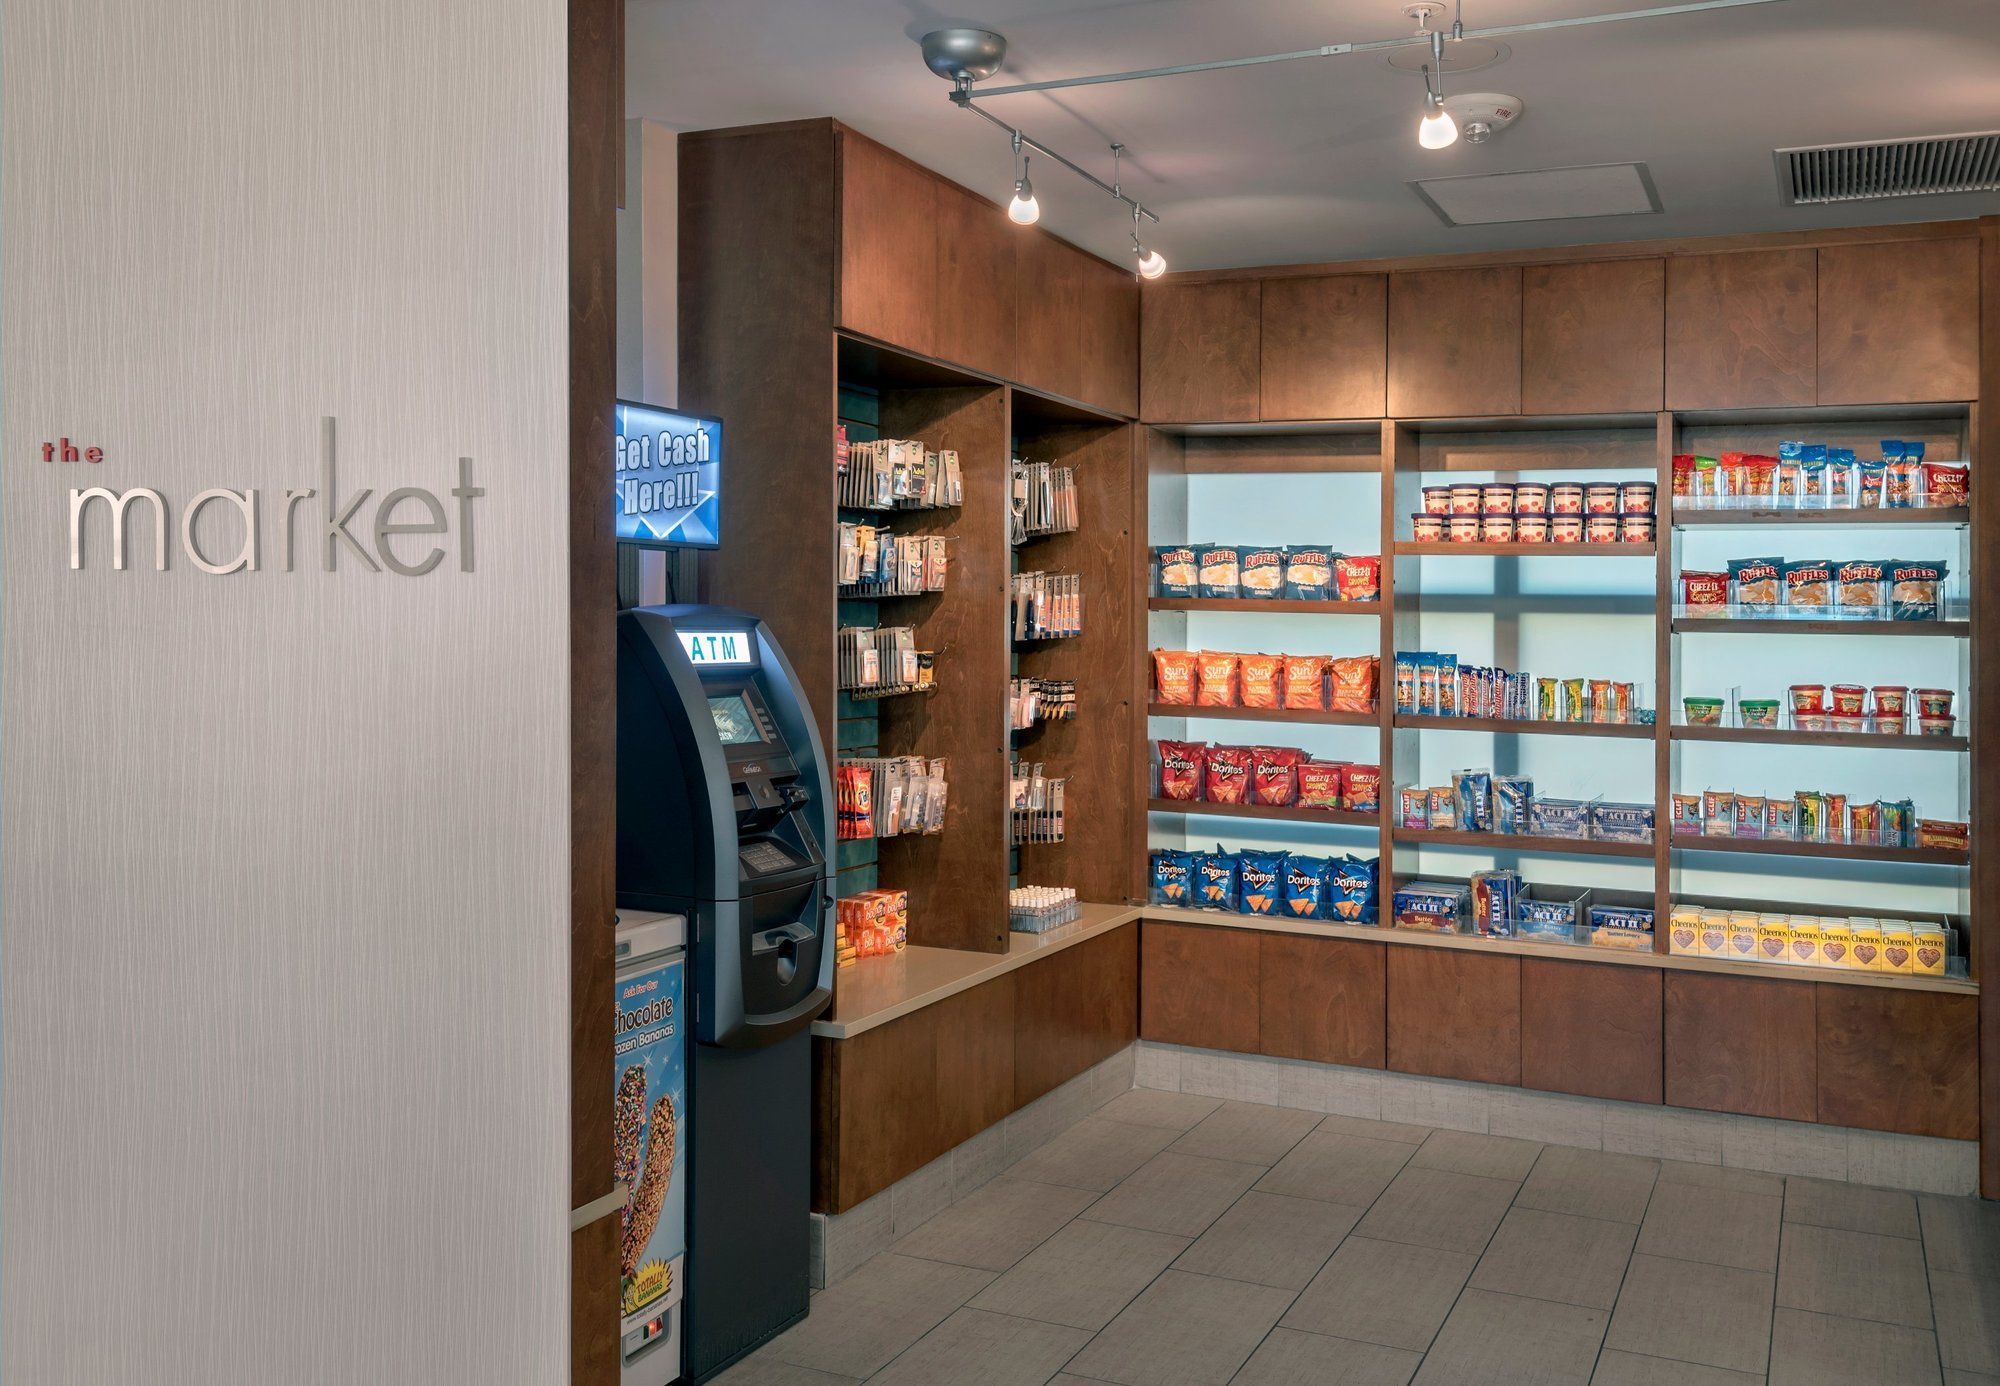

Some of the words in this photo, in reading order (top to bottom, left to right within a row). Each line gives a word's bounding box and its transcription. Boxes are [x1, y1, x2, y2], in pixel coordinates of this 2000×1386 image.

[41, 437, 104, 464] the
[616, 433, 651, 472] Get
[657, 427, 710, 468] Cash
[69, 415, 486, 577] market
[624, 470, 700, 517] Here!!!
[1161, 550, 1195, 566] RUFFLES
[1203, 550, 1237, 566] RUFFLES
[1245, 553, 1279, 569] RUFFLES
[1291, 552, 1327, 565] RUFFLES
[1739, 566, 1778, 582] RUFFLES
[1786, 569, 1829, 586] RUFFLES
[1839, 566, 1883, 582] RUFFLES
[1894, 568, 1938, 581] RUFFLES
[691, 636, 737, 661] ATM
[1164, 666, 1186, 681] Sun
[1204, 666, 1230, 680] Sun
[1246, 666, 1268, 681] Sun
[1289, 665, 1311, 681] Sun
[1164, 758, 1195, 770] Doritos
[1211, 762, 1244, 775] Doritos
[1257, 764, 1288, 775] Doritos
[1608, 812, 1625, 820] ACT
[1158, 865, 1187, 875] Doritos
[1201, 866, 1230, 877] Doritos
[1242, 871, 1275, 882] Doritos
[1287, 874, 1321, 886] Doritos
[1333, 877, 1368, 889] Doritos
[1410, 903, 1428, 912] ACT
[1428, 903, 1438, 912] II
[1491, 894, 1501, 912] ACT
[1414, 915, 1434, 923] Butter
[1533, 911, 1551, 920] ACT
[1608, 919, 1626, 928] ACT
[1627, 920, 1638, 928] II
[1671, 919, 1698, 929] Cheerios
[1700, 921, 1727, 931] Cheerios
[1730, 924, 1758, 933] Cheerios
[1760, 927, 1788, 937] Cheerios
[1790, 930, 1819, 939] Cheerios
[1820, 932, 1849, 942] Cheerios
[1851, 934, 1880, 944] Cheerios
[1882, 937, 1912, 947] Cheerios
[1914, 937, 1944, 948] Cheerios
[623, 984, 636, 999] Ask
[639, 1024, 674, 1047] Bananas
[636, 1269, 665, 1294] TOTALLY
[637, 1281, 663, 1303] BANANAS
